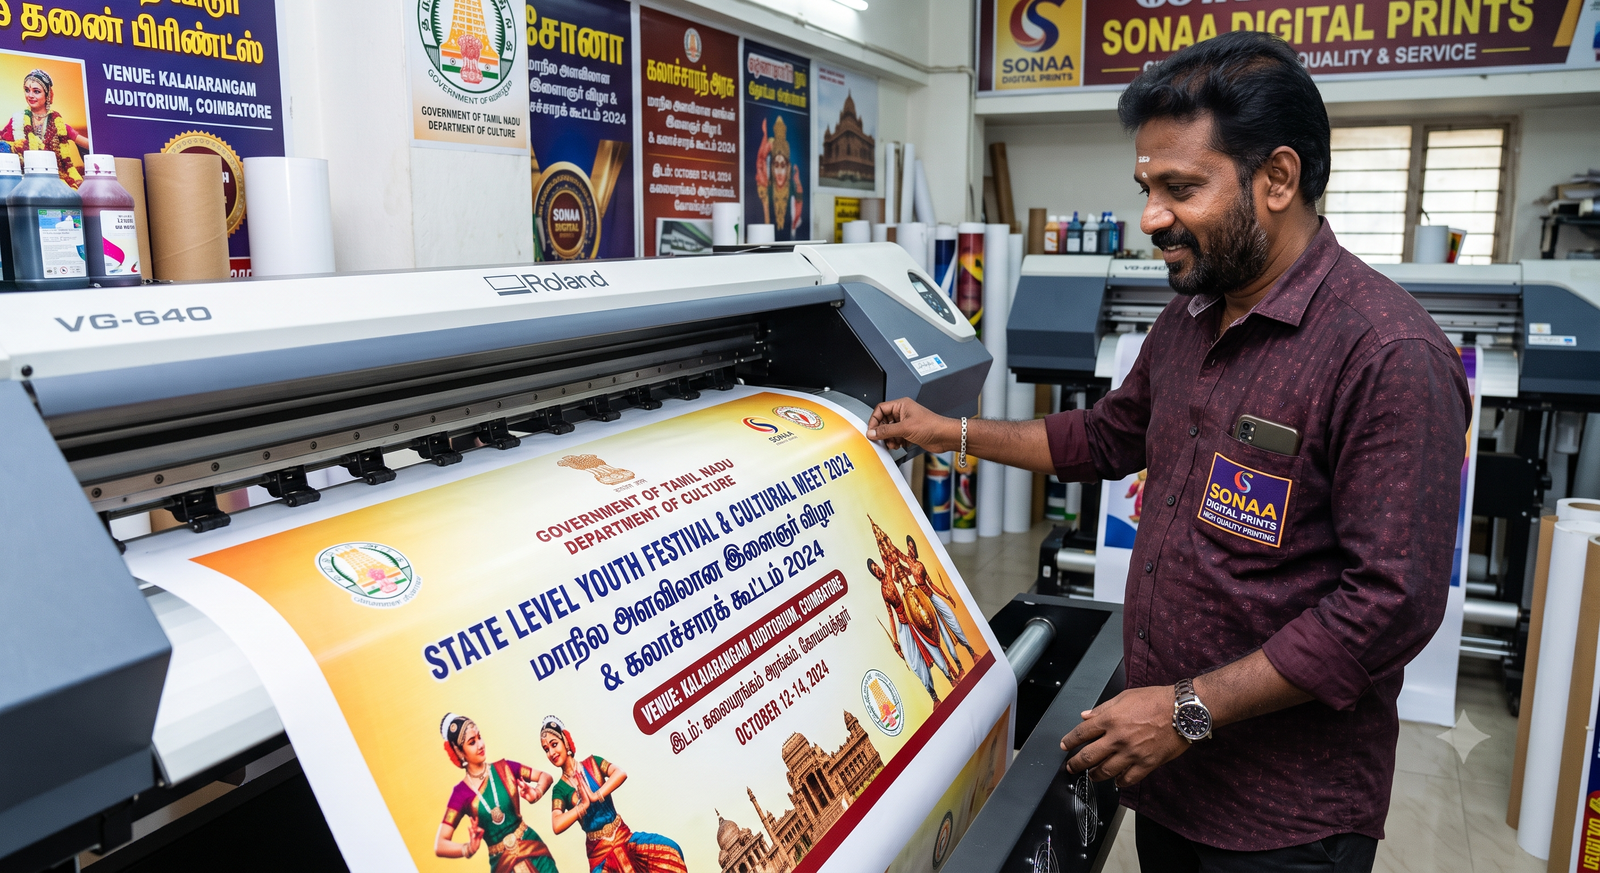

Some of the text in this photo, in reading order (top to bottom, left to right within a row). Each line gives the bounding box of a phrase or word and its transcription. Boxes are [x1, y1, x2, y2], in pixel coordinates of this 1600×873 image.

[131, 13, 264, 64] பிரிண்ட்ஸ்
[1101, 13, 1218, 56] SONAA
[1387, 0, 1534, 39] PRINTS
[1002, 55, 1074, 74] SONAA
[1298, 42, 1477, 68] QUALITY & SERVICE
[102, 63, 257, 97] VENUE: KALAIARANGAM
[427, 69, 478, 105] GOVERNMENT
[479, 96, 489, 105] OF
[1002, 72, 1073, 84] DIGITAL PRINTS
[104, 88, 272, 120] AUDITORIUM, COIMBATORE
[610, 92, 618, 105] &
[421, 106, 521, 126] GOVERNMENT OF TAMIL NADU
[428, 120, 516, 138] DEPARTMENT OF CULTURE
[602, 110, 627, 125] 2024
[648, 131, 655, 144] &
[717, 141, 736, 153] 2024
[552, 208, 580, 221] SONAA
[521, 270, 609, 293] Roland
[54, 306, 213, 332] VG-640
[536, 494, 641, 542] GOVERNMENT
[641, 486, 661, 501] OF
[660, 472, 702, 494] TAMIL
[699, 458, 735, 476] NADU
[564, 505, 660, 555] DEPARTMENT
[661, 498, 679, 513] OF
[680, 475, 737, 506] CULTURE
[1206, 498, 1277, 531] DIGITAL PRINTS
[1209, 483, 1277, 520] SONAA
[1202, 511, 1276, 543] HIGH QUALITY PRINTING
[424, 452, 855, 680] STATE LEVEL YOUTH FESTIVAL & CULTURAL MEET 2024
[530, 499, 835, 682] மாநில அளவிலான இளைஞர் விழா
[600, 539, 826, 692] & கலாச்சாரக் கூட்டம் 2024
[640, 575, 845, 726] VENUE: KALAIARANGAM AUDITORIUM, COIMBATORE
[669, 718, 703, 755] இடம்:
[702, 670, 765, 730] கலையரங்கம்
[735, 659, 830, 746] OCTOBER 12-14, 2024
